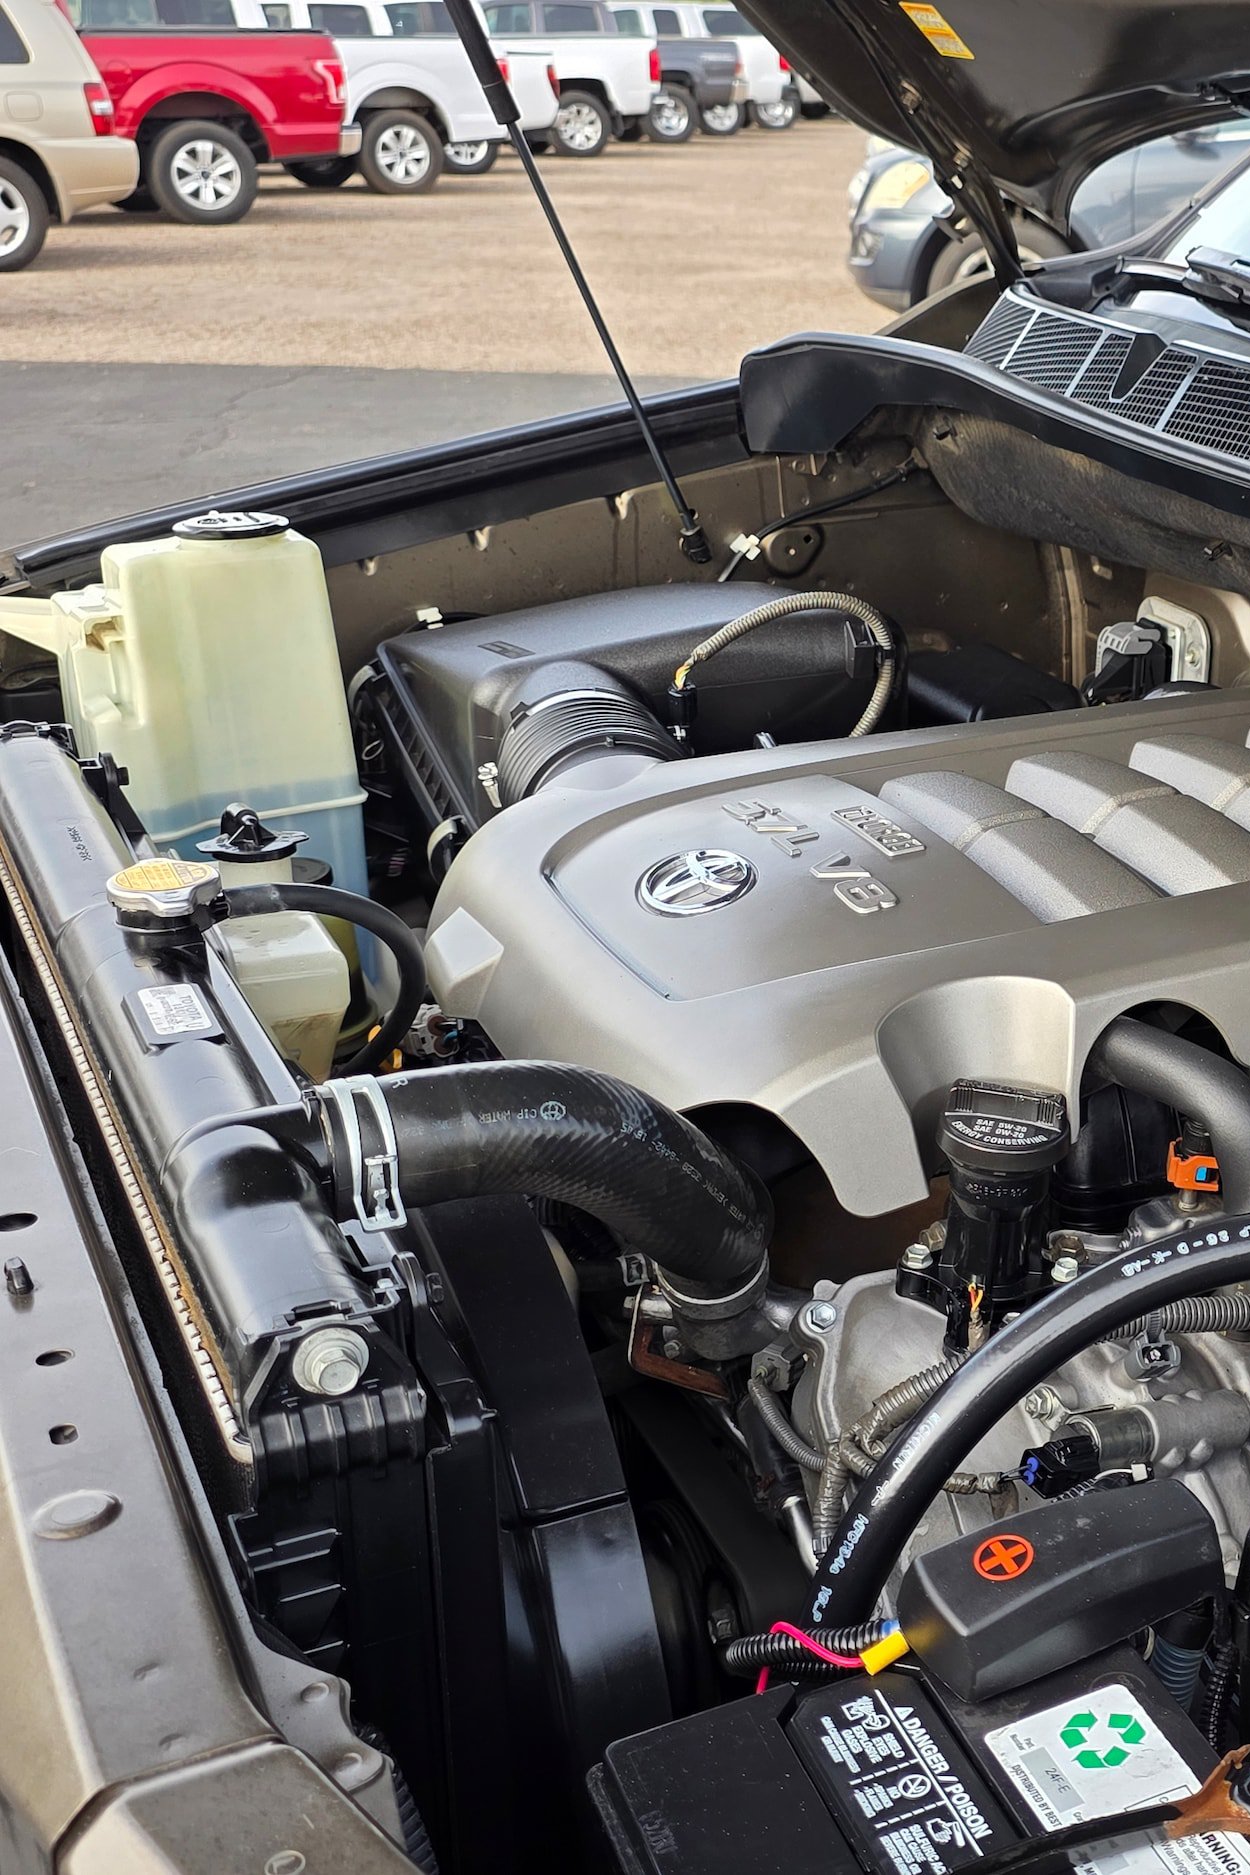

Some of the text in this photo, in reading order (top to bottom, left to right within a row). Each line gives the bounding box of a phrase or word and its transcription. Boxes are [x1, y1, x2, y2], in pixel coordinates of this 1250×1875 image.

[809, 850, 899, 914] V8
[952, 1120, 1049, 1146] ENERGY CONSERVING
[973, 1124, 1025, 1139] SAE 0W-20
[975, 1118, 1028, 1133] SAE 5W-20
[903, 1717, 950, 1777] DANGER
[945, 1783, 993, 1839] POISON
[1044, 1768, 1071, 1793] 24F-E
[1011, 1764, 1062, 1827] DISTRIBUTED BY BEST
[909, 1823, 940, 1862] SULFURIC
